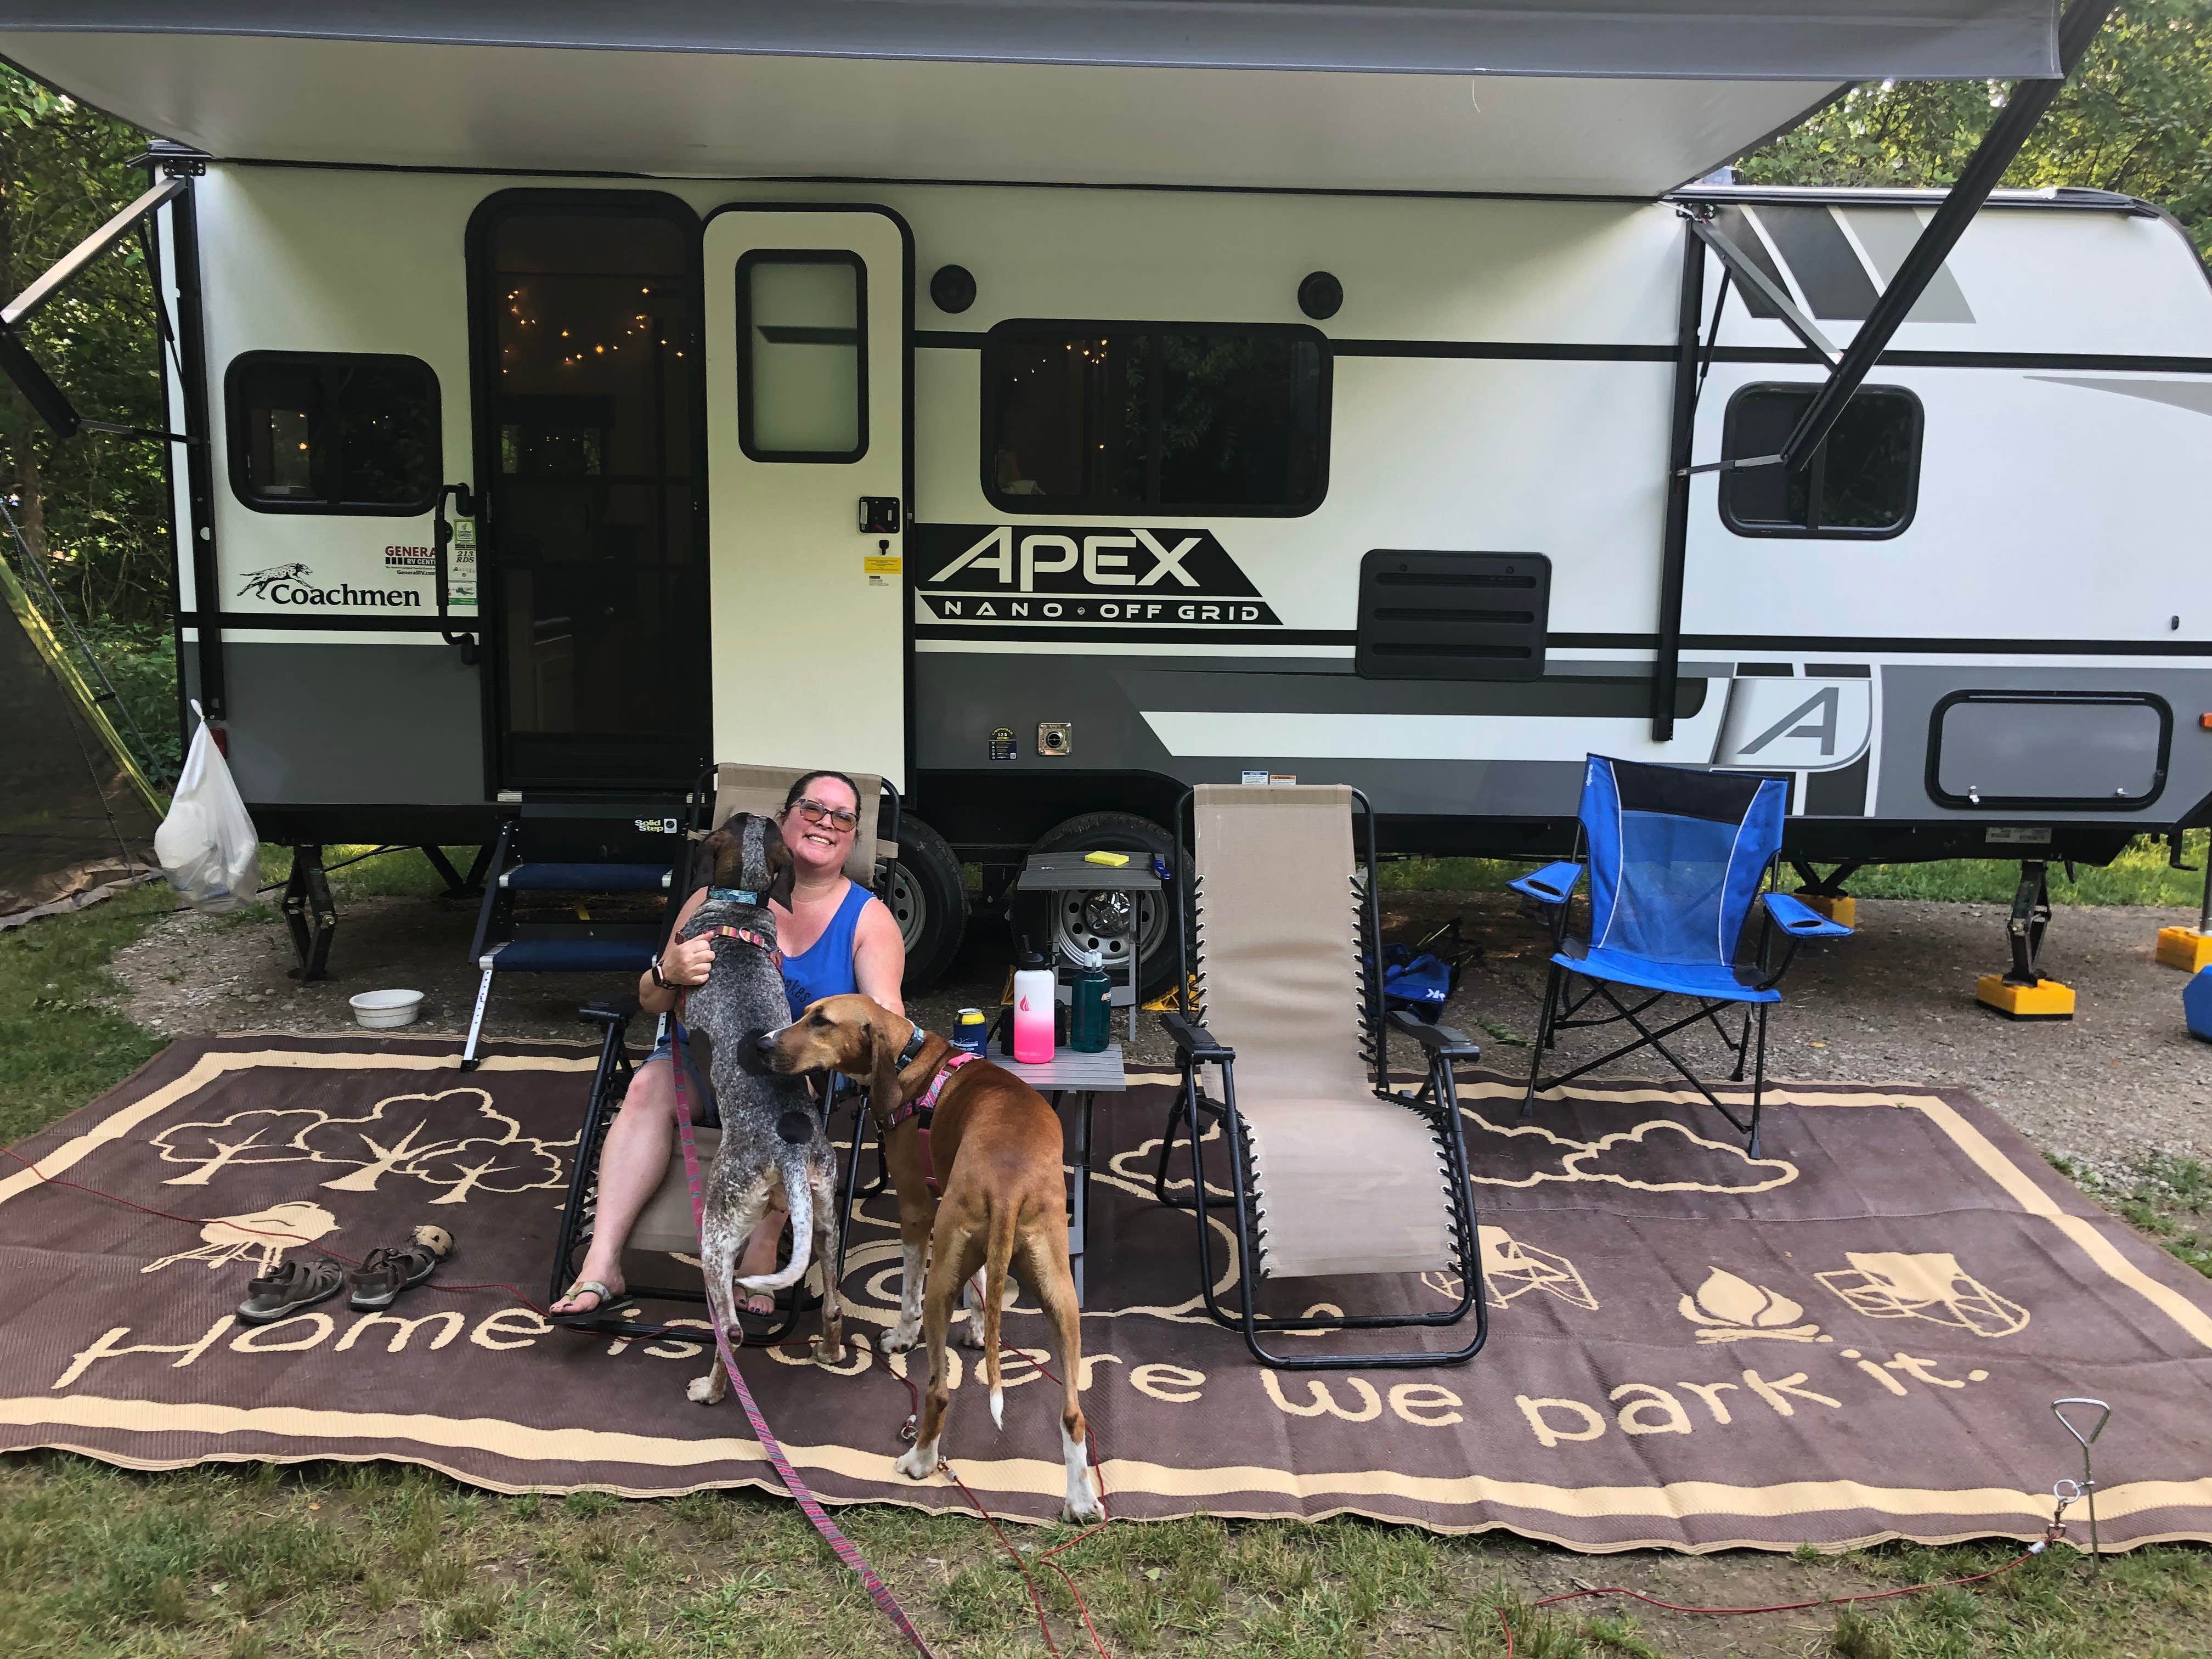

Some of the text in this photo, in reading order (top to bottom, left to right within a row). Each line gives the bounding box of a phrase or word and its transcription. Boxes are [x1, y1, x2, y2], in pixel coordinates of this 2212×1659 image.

[928, 527, 1202, 591] APEX
[271, 584, 421, 607] Coachmen
[945, 602, 1259, 620] NANO OFF GRID
[50, 1307, 555, 1389] Home
[607, 1308, 714, 1359] is
[1259, 1368, 1464, 1427] we
[1516, 1369, 1842, 1448] park
[1839, 1348, 1990, 1396] it.
